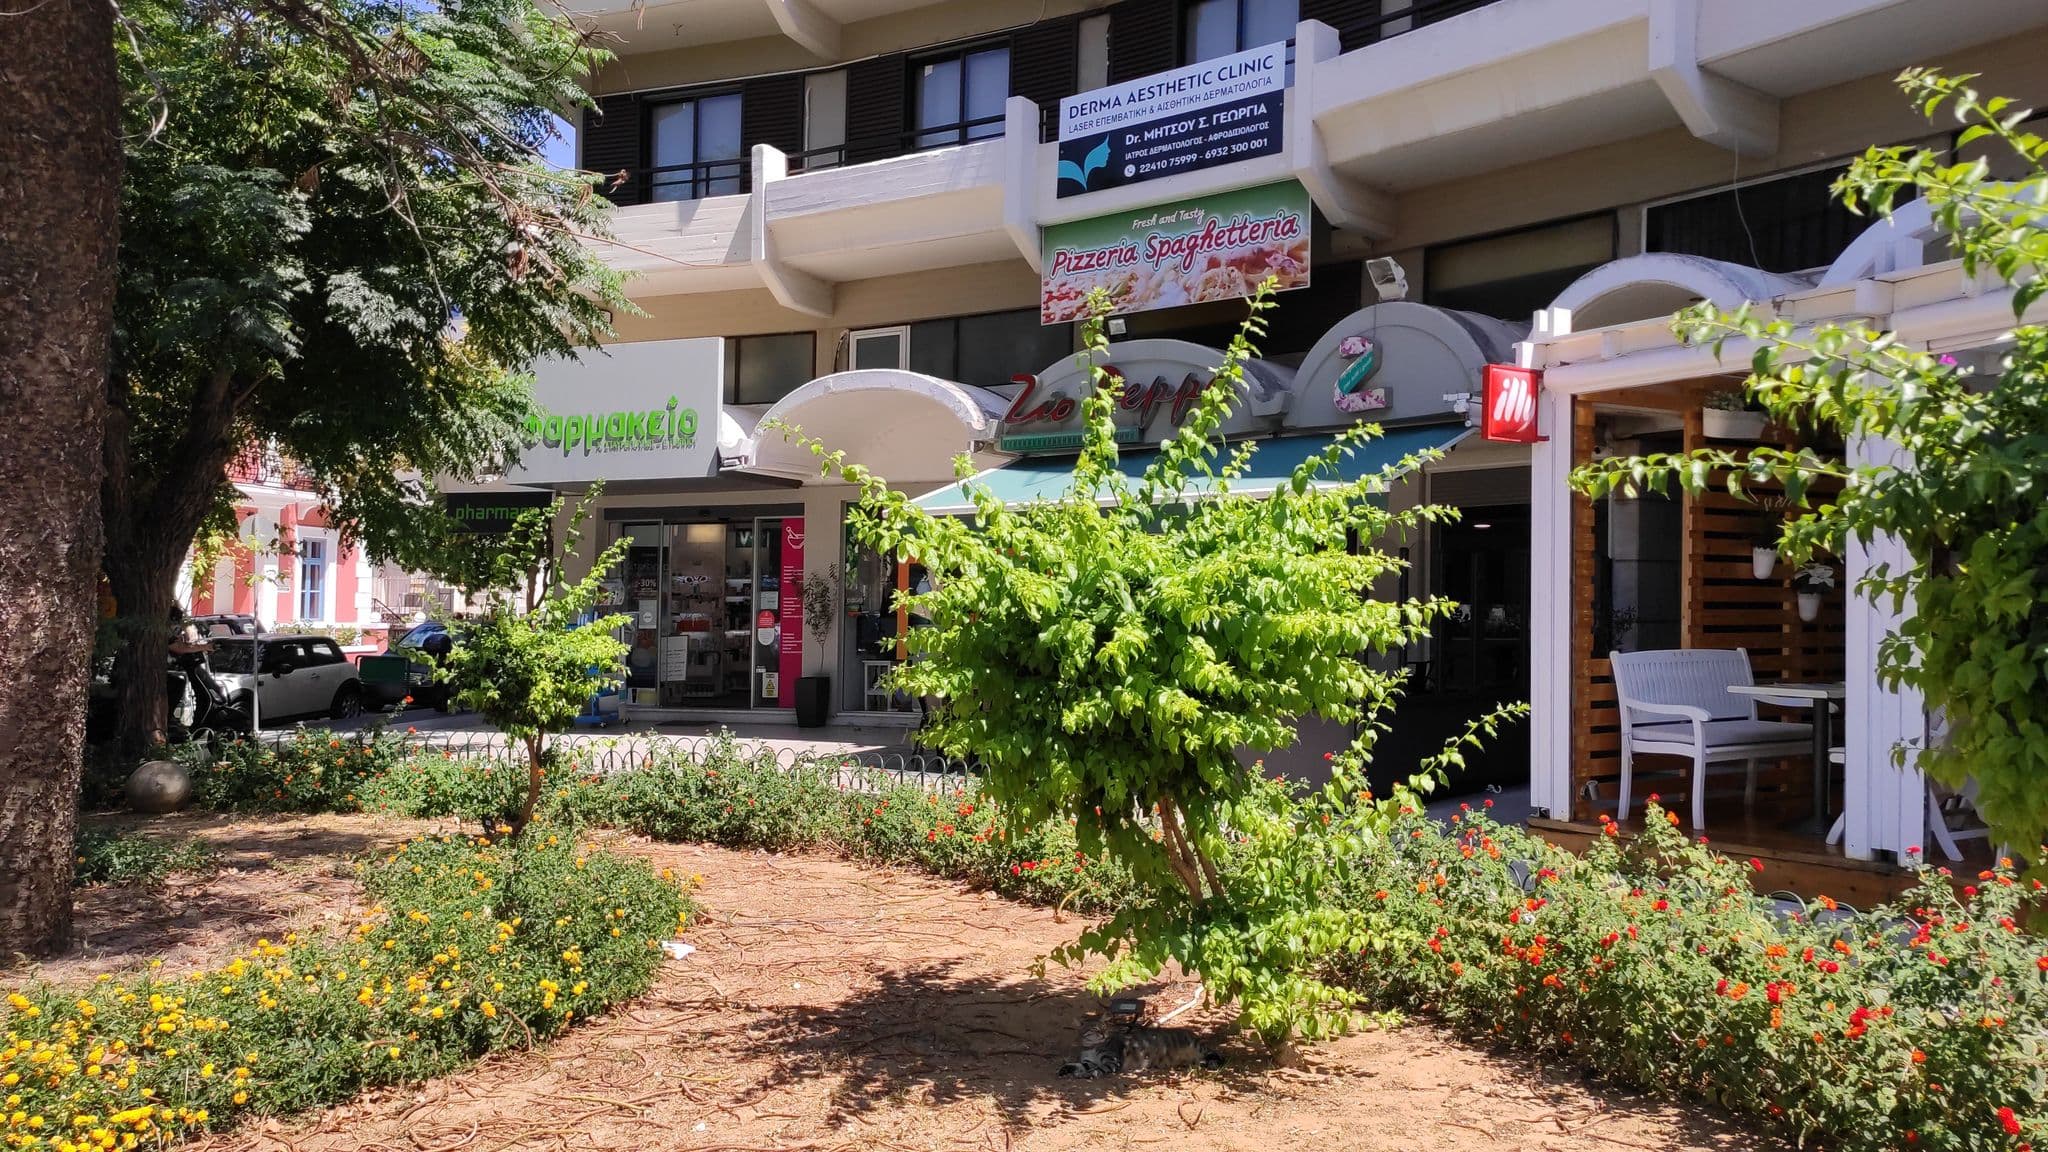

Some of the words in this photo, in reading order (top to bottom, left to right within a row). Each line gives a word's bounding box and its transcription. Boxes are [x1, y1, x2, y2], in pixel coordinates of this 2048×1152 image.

[1069, 96, 1121, 119] DERMA
[1127, 71, 1213, 105] AESTHETIC
[1218, 55, 1273, 81] CLINIC
[1069, 120, 1094, 133] LASER
[1096, 106, 1147, 127] ΕΠΕΜΒΑΤΙΚΗ
[1149, 105, 1154, 114] &
[1157, 94, 1201, 111] ΑΙΣΘΗΤΙΚΗ
[1203, 76, 1272, 101] ΔΕΡΜΑΤΟΛΟΓΙΑ
[1125, 133, 1141, 145] Dr.
[1144, 119, 1196, 141] ΜΗΤΣΟΥ
[1212, 102, 1267, 126] ΓΕΩΡΓΙΑ
[1125, 148, 1149, 160] ΙΑΤΡΟΣ
[1149, 136, 1203, 155] ΔΕΡΜΑΤΟΛΟΓΟΣ
[1140, 160, 1167, 173] 22410
[1169, 153, 1197, 167] 75999
[1205, 146, 1229, 159] 6932
[1230, 142, 1249, 154] 300
[1250, 138, 1268, 149] 001
[1132, 213, 1158, 229] Fresh
[1159, 211, 1178, 224] and
[1179, 208, 1205, 223] Tasty
[1050, 239, 1139, 278] Pizzeria
[1144, 211, 1300, 273] Spaghetteria
[1493, 377, 1536, 433] illy
